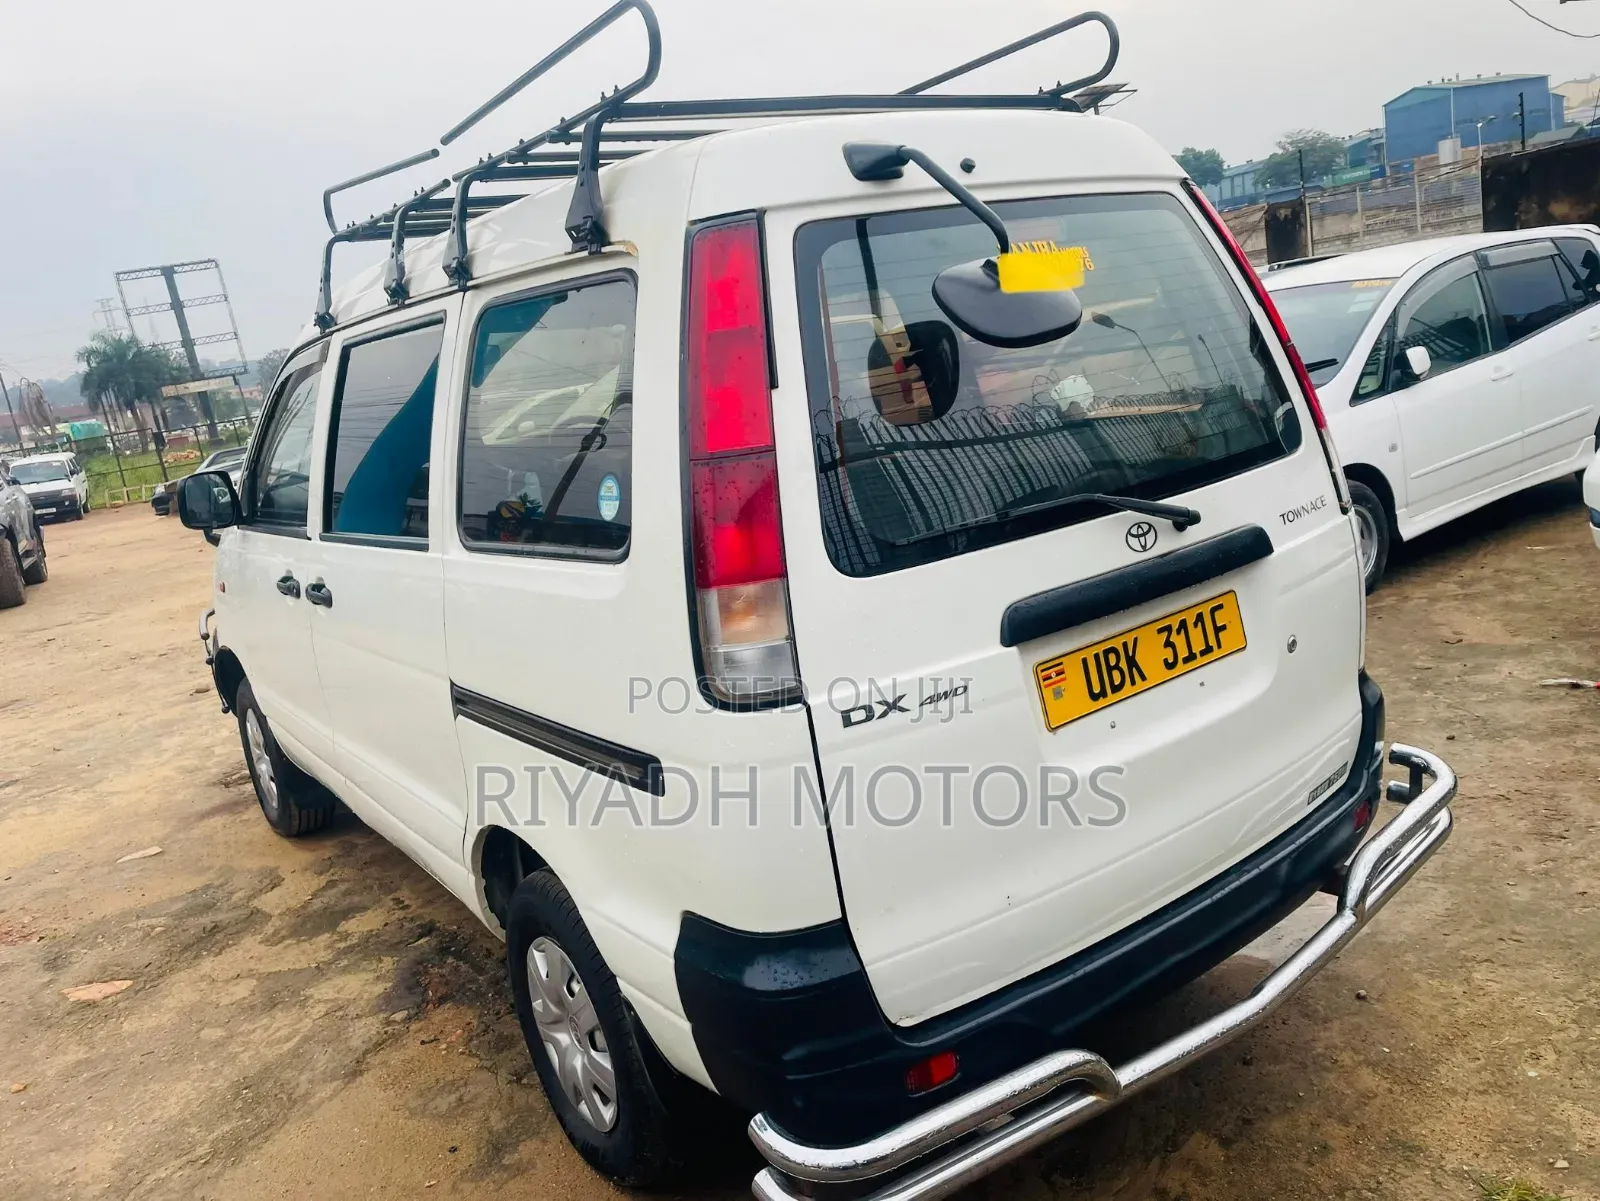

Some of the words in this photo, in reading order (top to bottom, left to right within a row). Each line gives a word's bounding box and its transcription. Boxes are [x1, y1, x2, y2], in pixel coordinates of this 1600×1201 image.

[1279, 494, 1327, 526] TOWNACE
[1081, 636, 1147, 702] UBK
[1156, 603, 1227, 671] 311F
[840, 693, 911, 729] DX
[918, 685, 968, 707] 4WD
